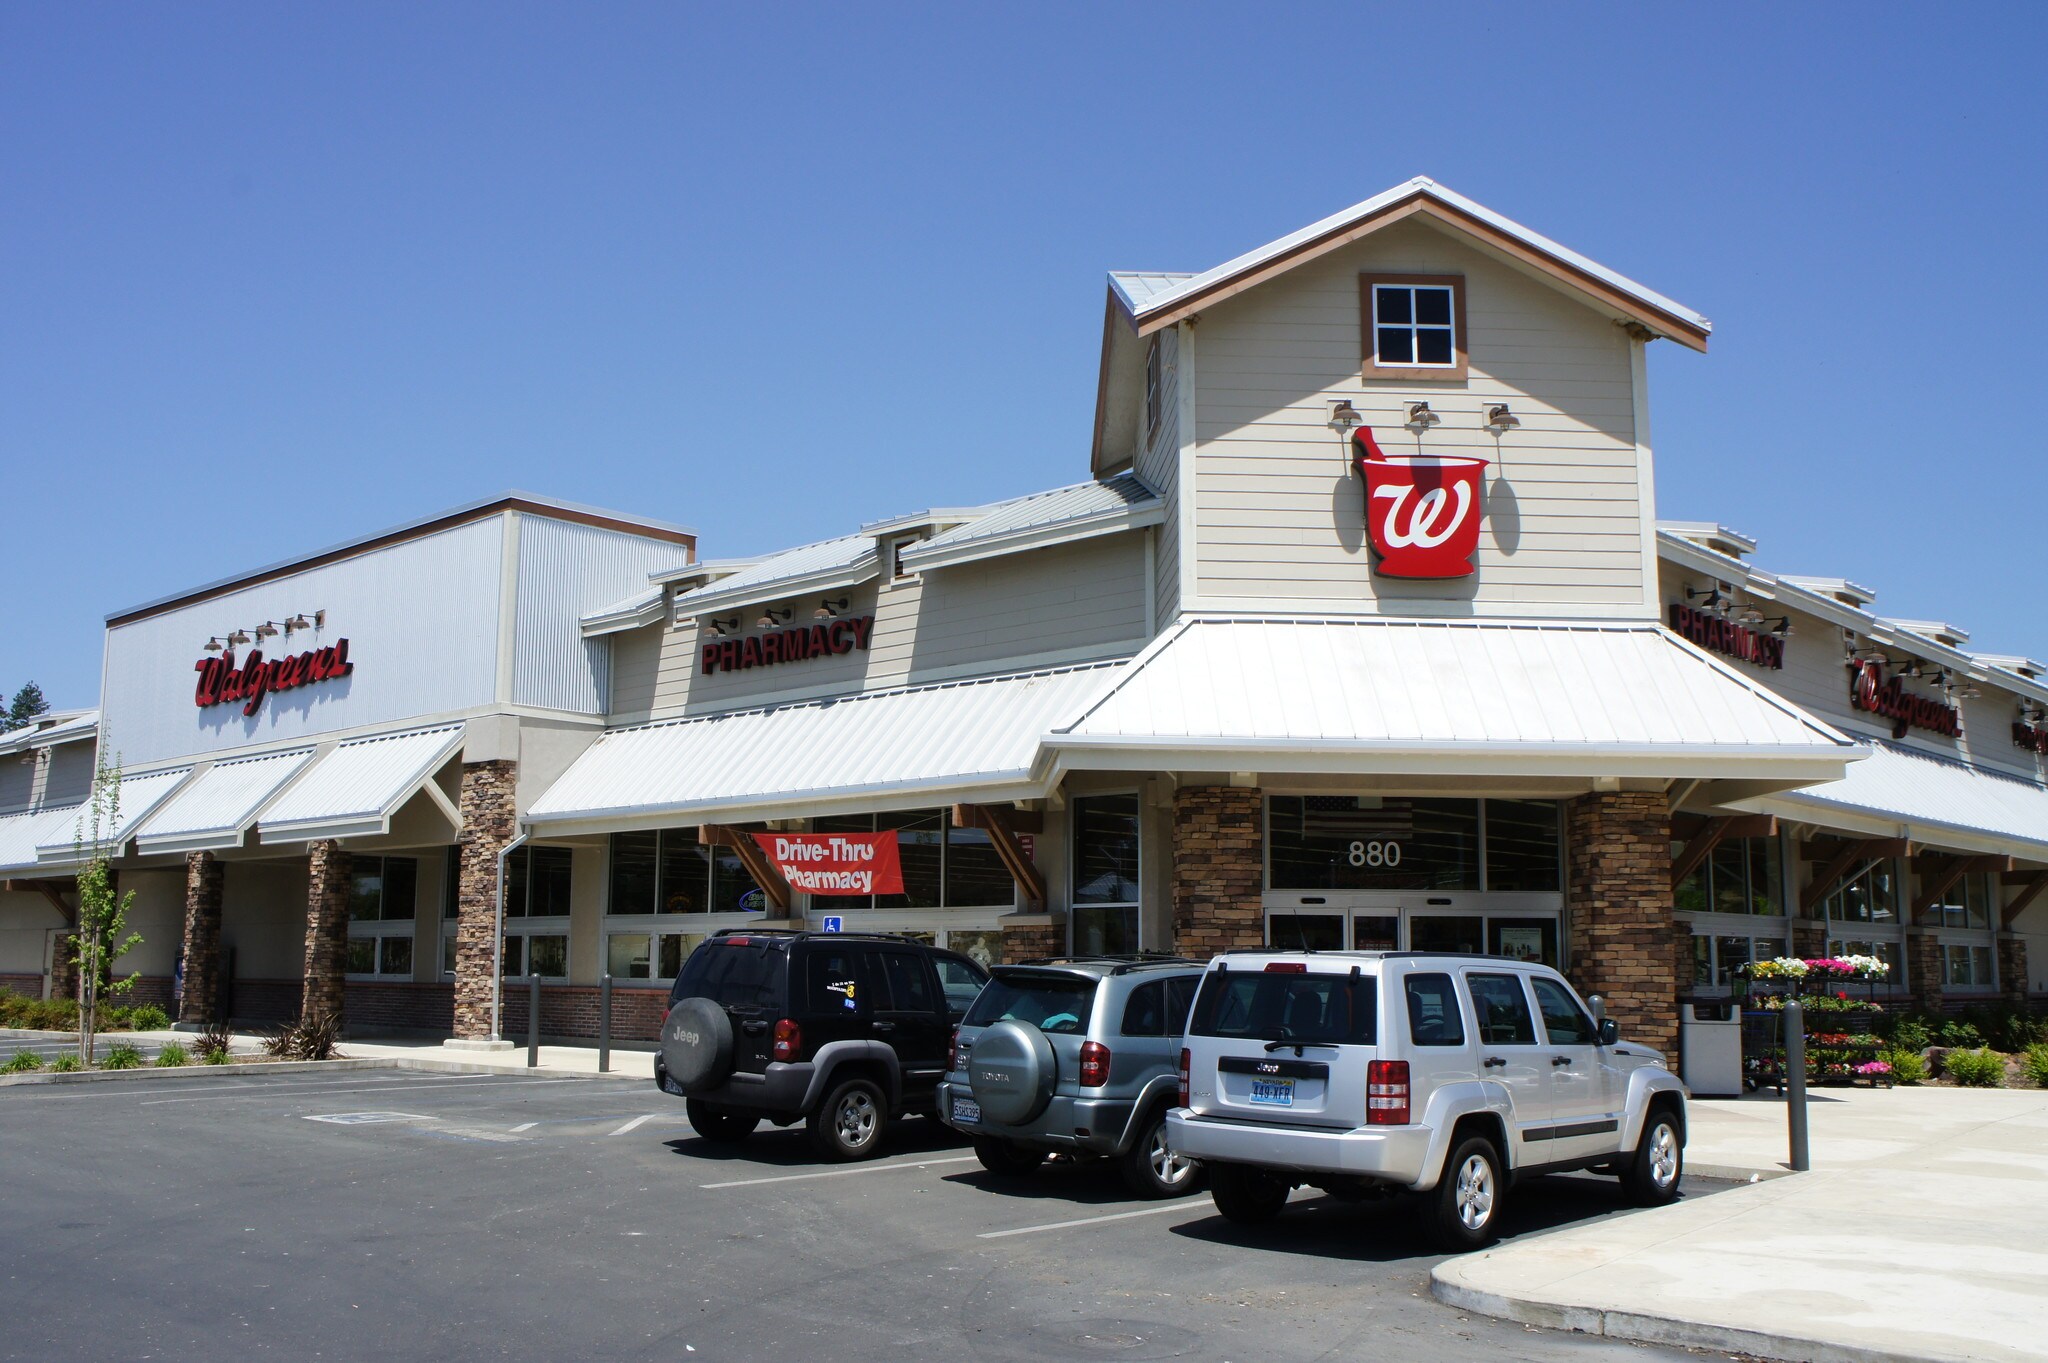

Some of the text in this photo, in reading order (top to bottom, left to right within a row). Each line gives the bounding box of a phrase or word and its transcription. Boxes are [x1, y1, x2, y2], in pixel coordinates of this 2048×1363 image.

[1373, 480, 1471, 549] W
[702, 616, 874, 674] PHARMACY
[1669, 604, 1784, 670] PHARMACY
[195, 638, 353, 717] Walgreens
[1846, 658, 1962, 739] Walgreens
[775, 838, 873, 862] Drive-Thru
[1348, 841, 1401, 867] 880
[782, 865, 872, 893] Pharmacy
[674, 1026, 699, 1047] Jeep
[981, 1072, 1010, 1082] TOYOTA
[1257, 1062, 1279, 1074] Jeep
